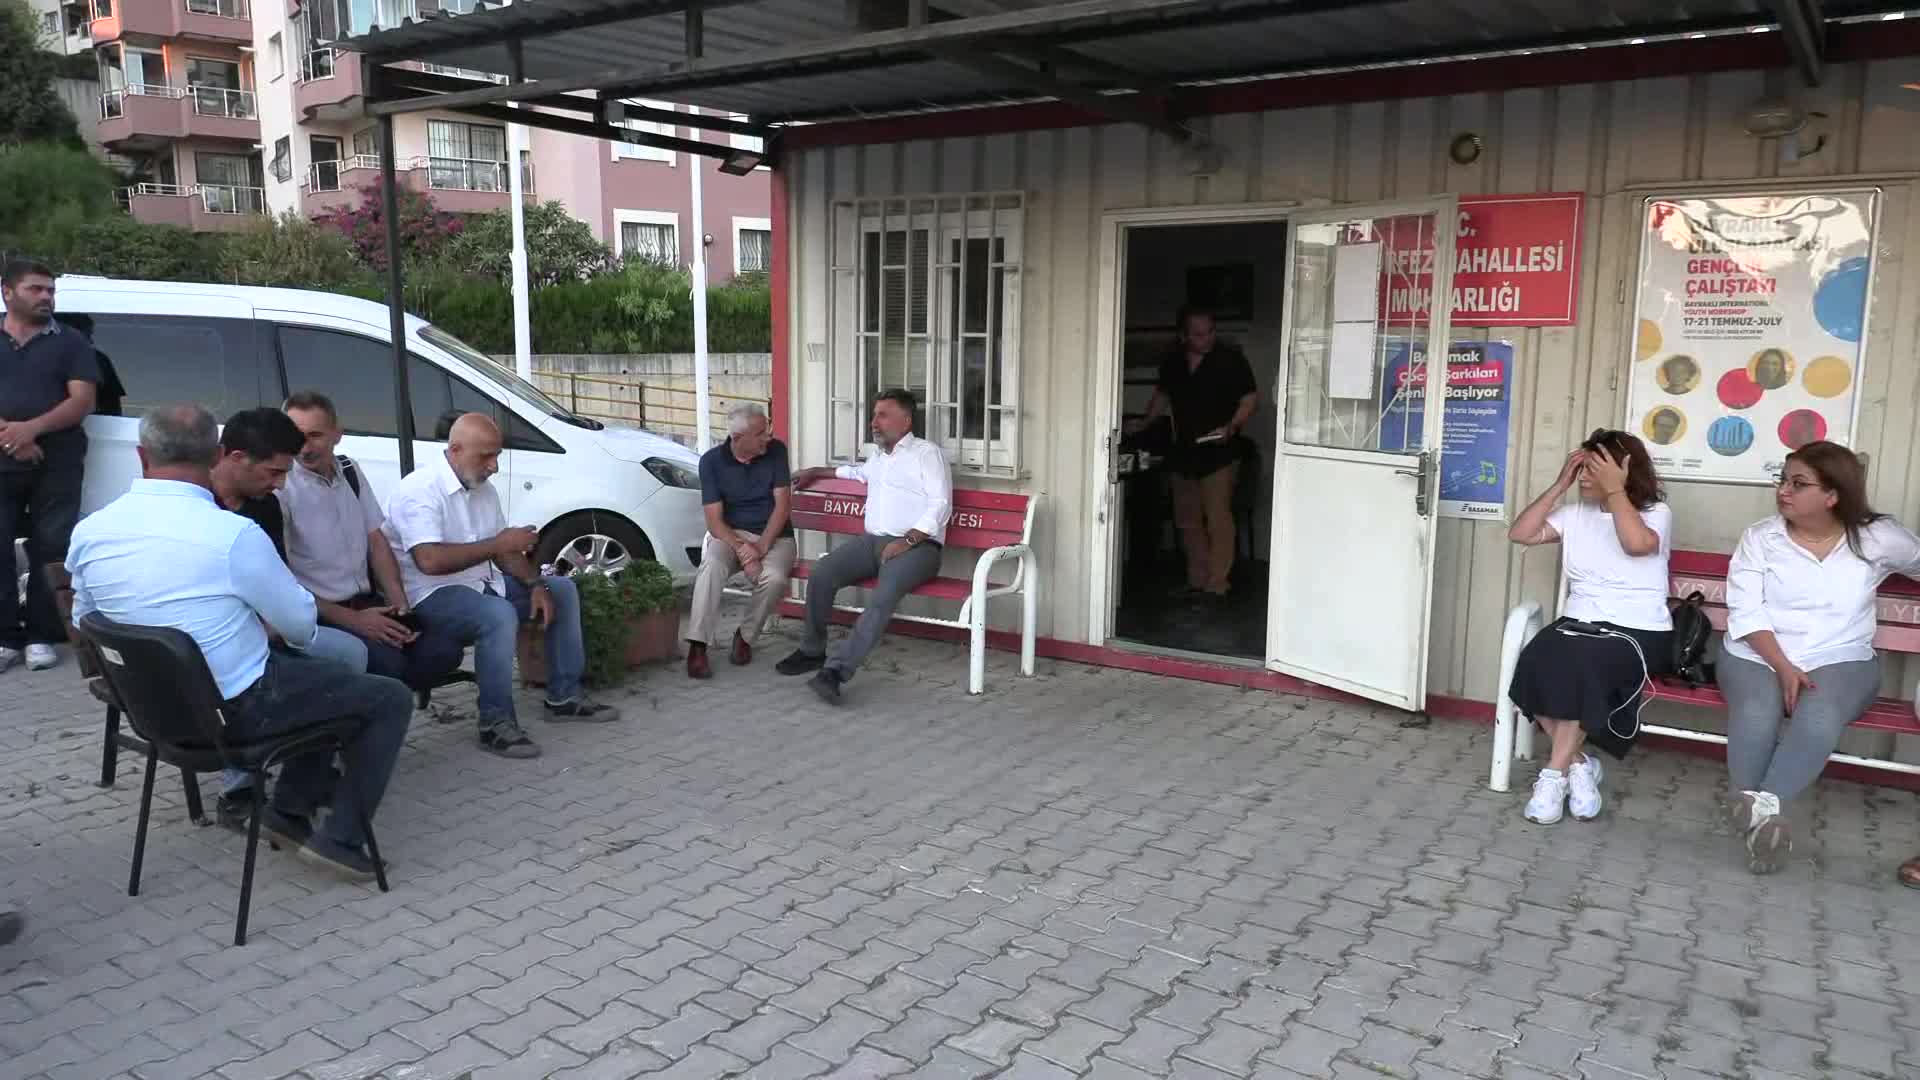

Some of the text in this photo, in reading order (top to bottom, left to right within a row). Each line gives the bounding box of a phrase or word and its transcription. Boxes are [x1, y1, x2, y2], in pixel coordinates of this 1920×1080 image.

[1384, 240, 1564, 274] RFEZ AHALLESİ
[1391, 282, 1520, 313] MUHARLIĞI
[1686, 278, 1777, 298] ÇALIŞTAYI
[1683, 317, 1709, 326] 17-21
[824, 499, 867, 516] BAYRA
